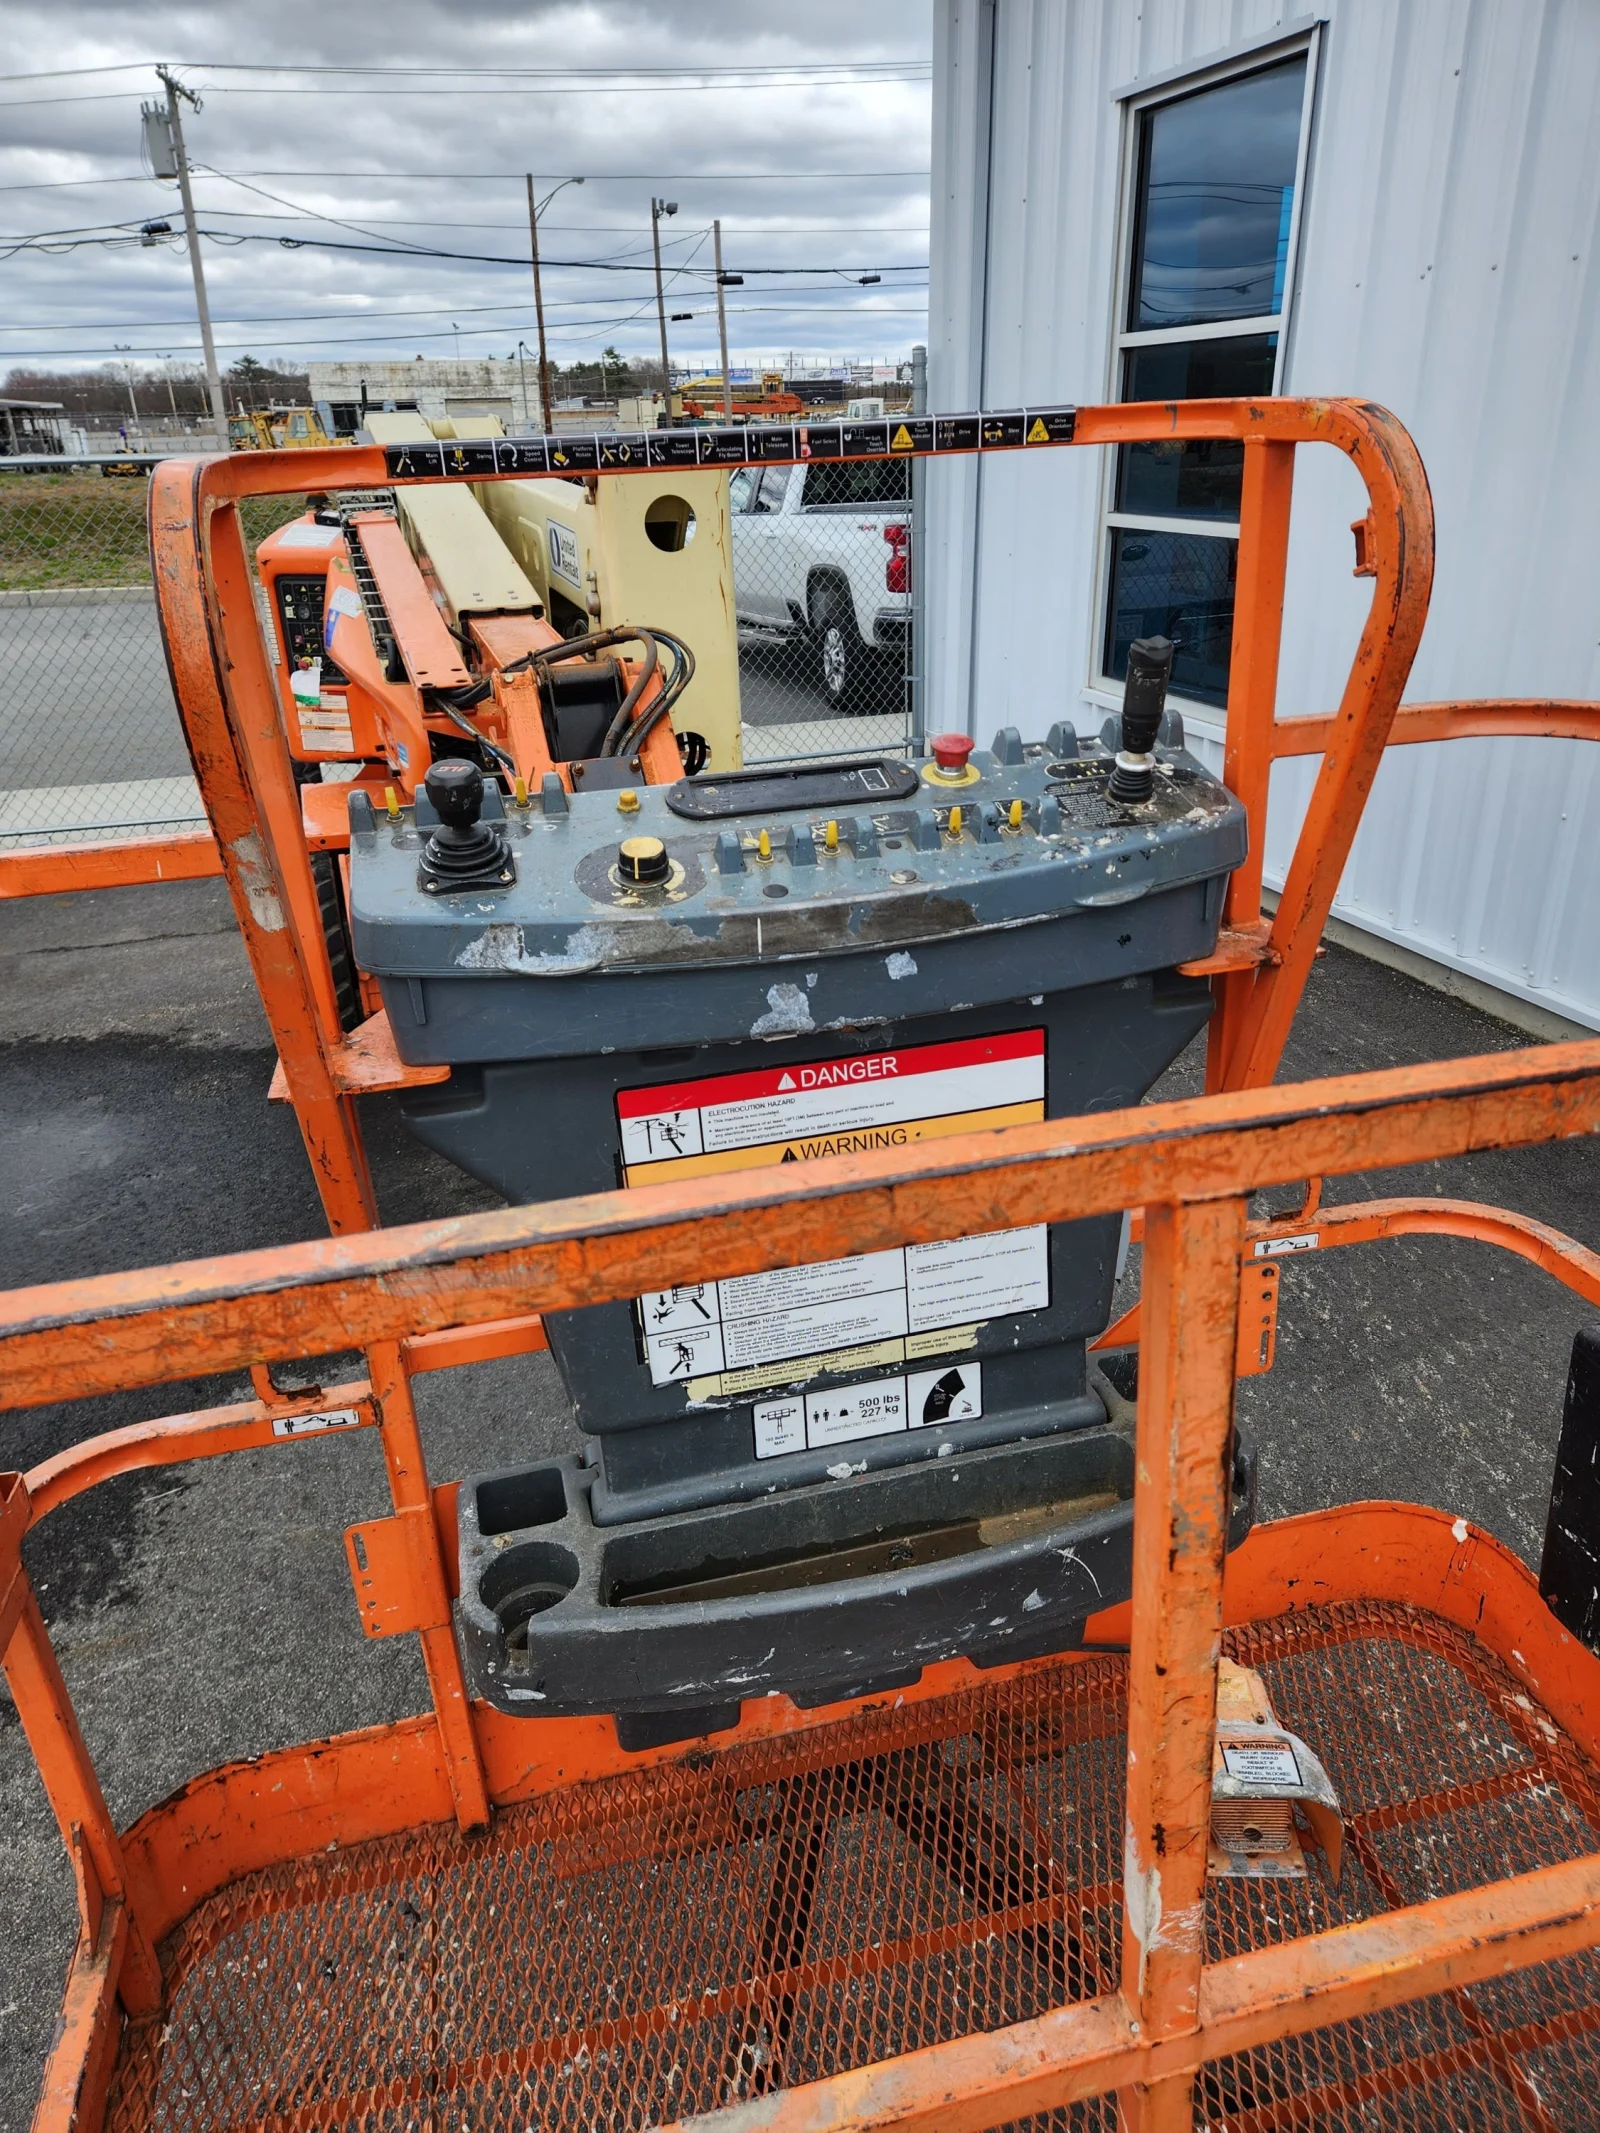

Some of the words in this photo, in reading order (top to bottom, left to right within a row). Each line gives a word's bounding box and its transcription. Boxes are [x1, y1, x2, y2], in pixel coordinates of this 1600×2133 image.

[560, 532, 575, 558] United
[562, 553, 578, 580] Rentals
[800, 1056, 898, 1087] DANGER
[708, 1102, 765, 1117] ELECTROCUTION
[767, 1098, 796, 1108] HAZARD
[800, 1129, 907, 1159] WARNING
[726, 1320, 761, 1330] CRUSHING
[762, 1314, 790, 1323] HAZARD
[858, 1398, 880, 1409] 500
[883, 1394, 900, 1403] lbs
[861, 1407, 881, 1418] 227
[885, 1405, 899, 1414] kg
[824, 1422, 862, 1432] UNRESTRICTED
[862, 1416, 886, 1425] CAPACITY
